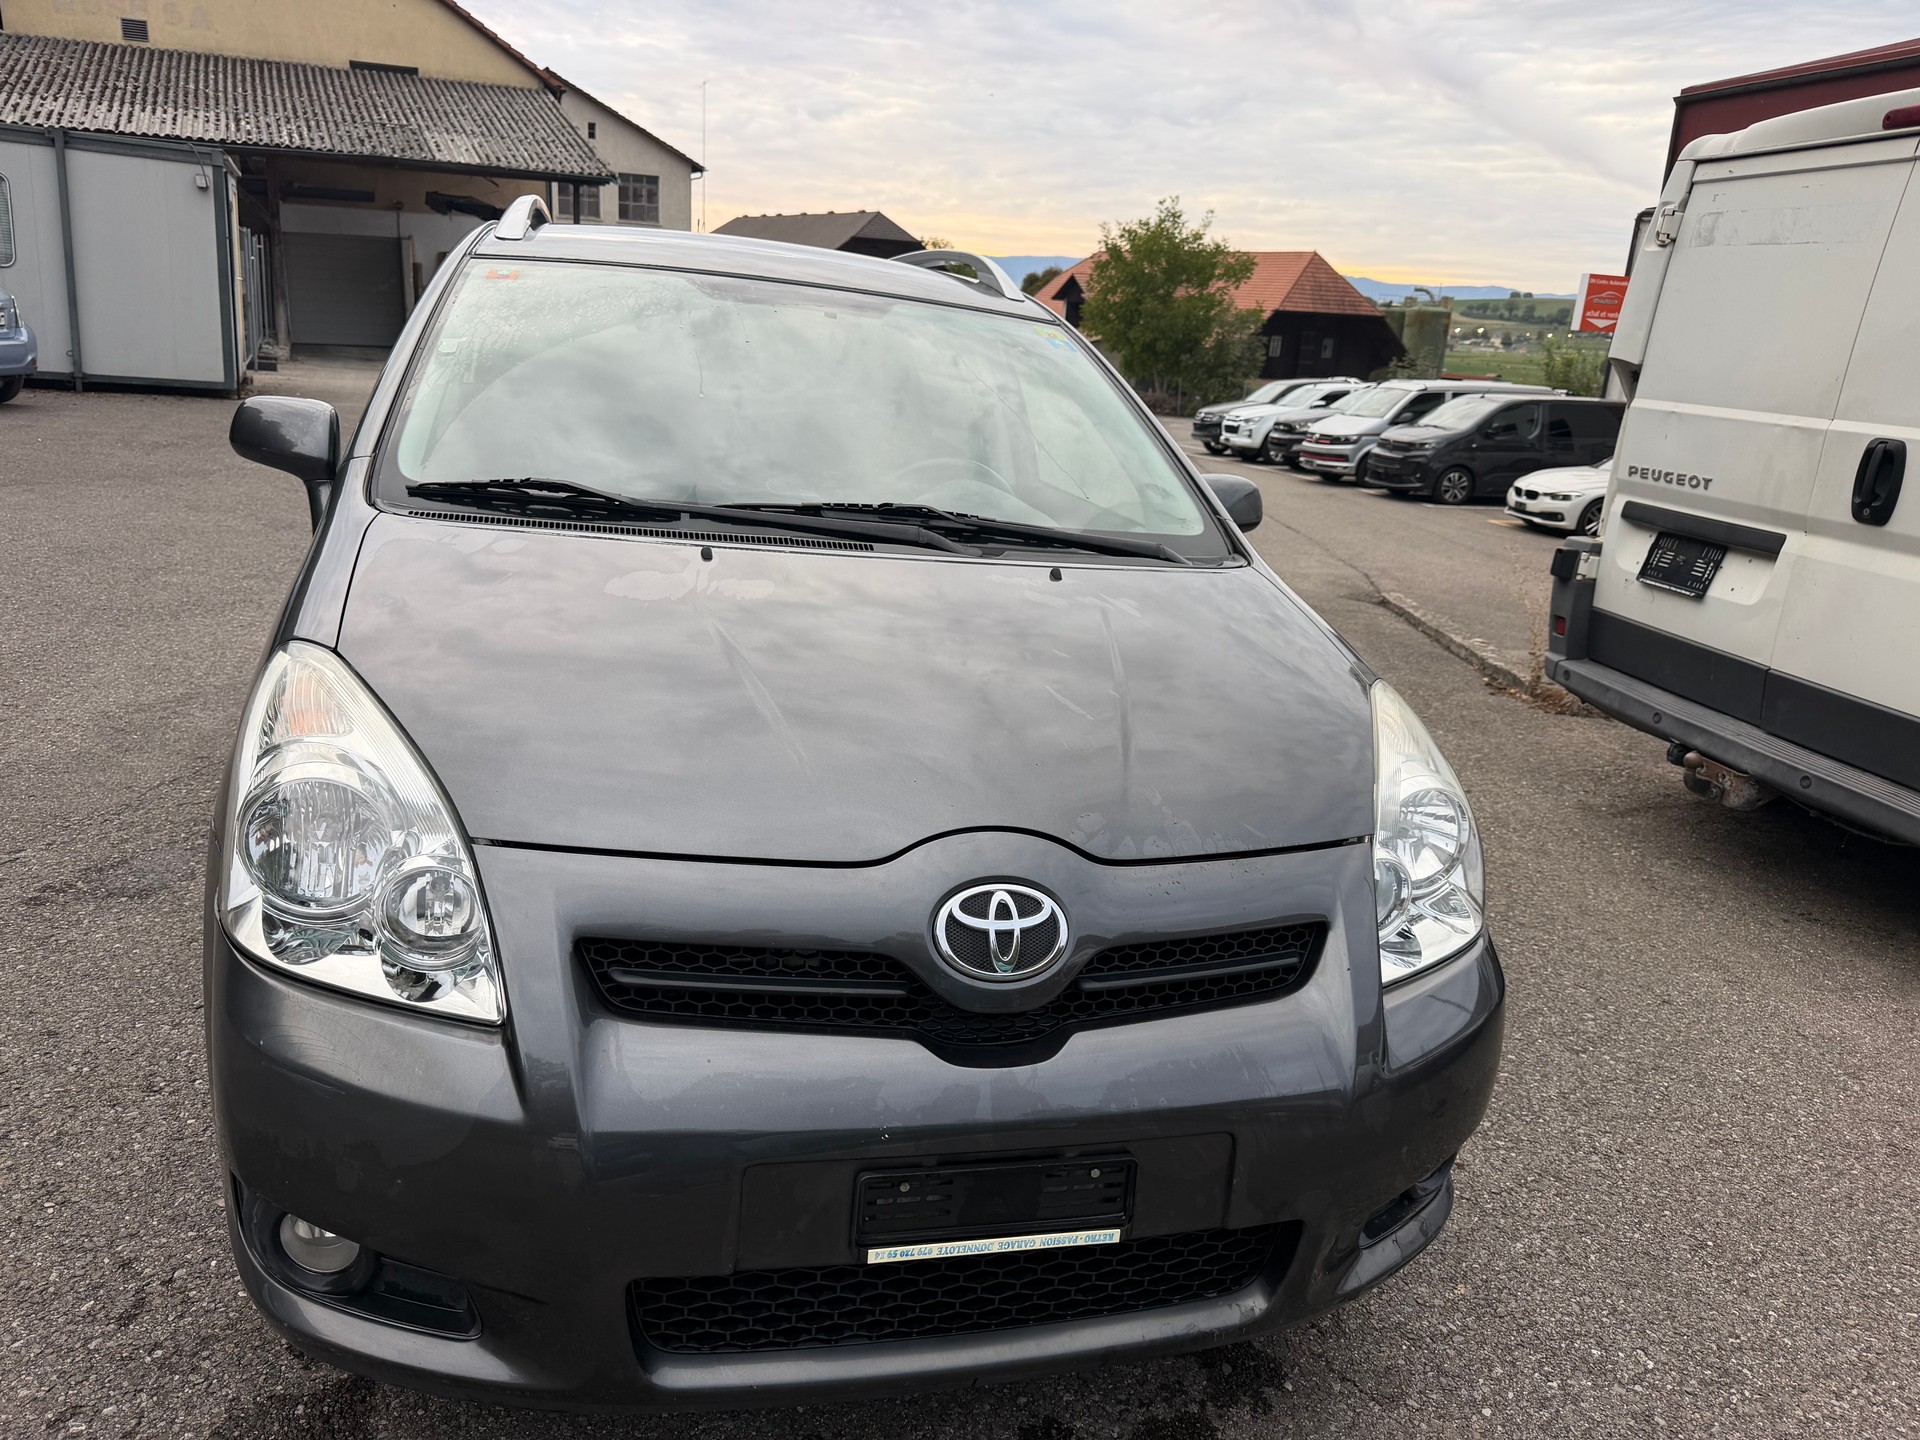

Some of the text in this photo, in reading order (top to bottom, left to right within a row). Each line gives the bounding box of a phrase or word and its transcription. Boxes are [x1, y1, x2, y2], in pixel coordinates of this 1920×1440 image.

[1628, 465, 1713, 490] PEUGEOT
[1039, 1235, 1079, 1248] PASSION
[1084, 1233, 1115, 1244] RETRO
[936, 1243, 995, 1256] DONNELOYE
[997, 1239, 1036, 1250] GARAGE
[887, 1249, 899, 1259] 59
[899, 1248, 915, 1258] 720
[917, 1248, 933, 1257] 079
